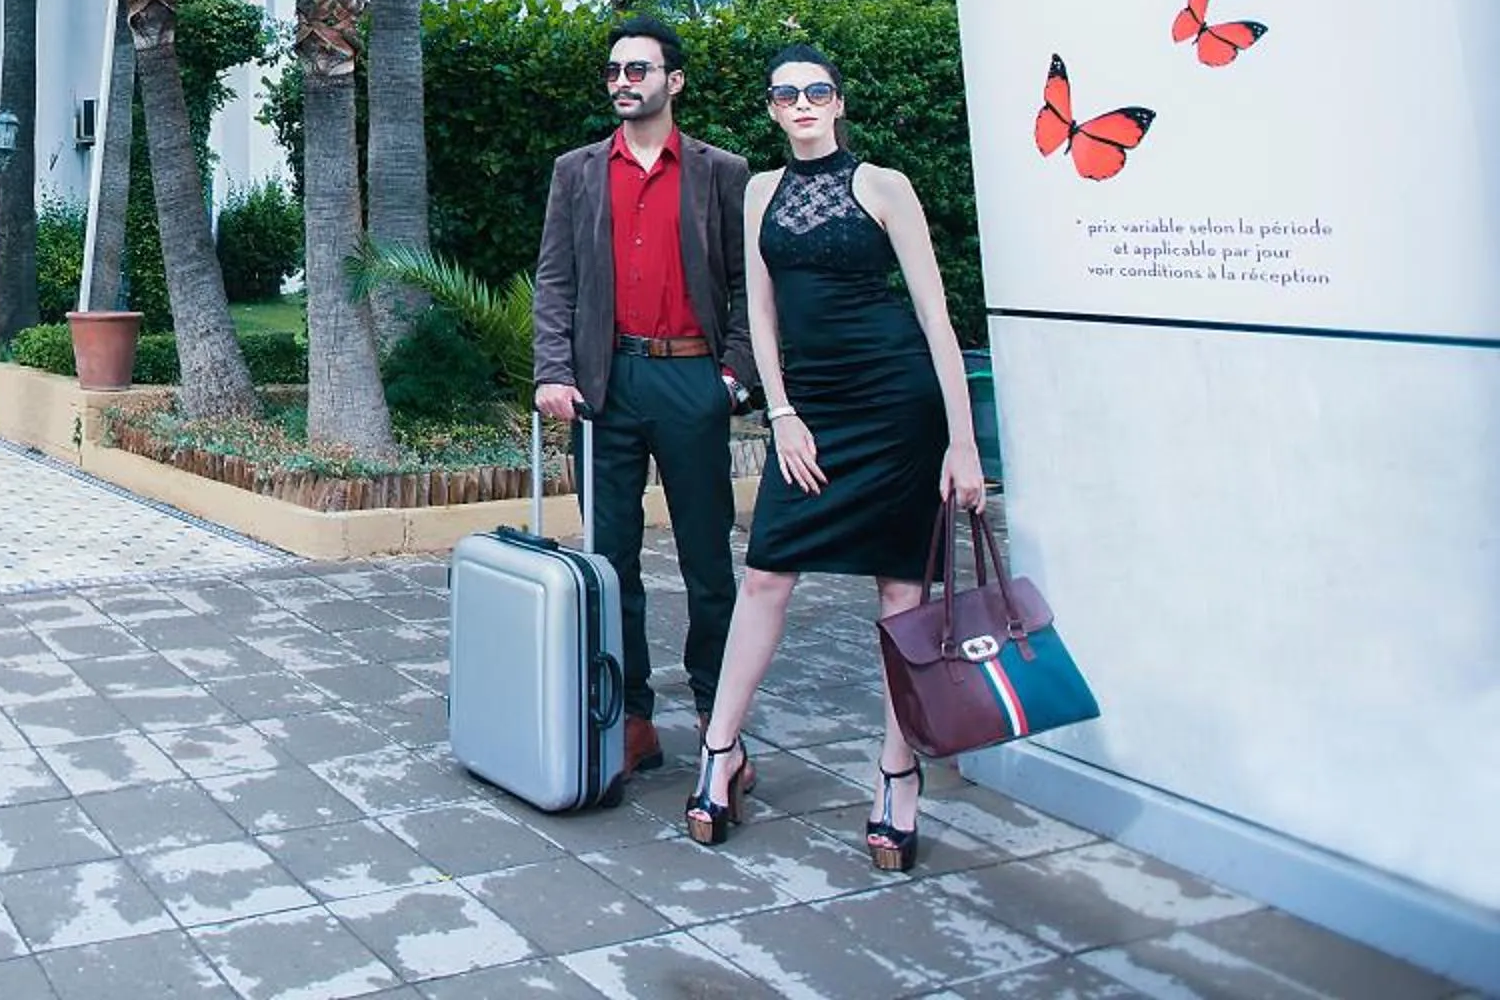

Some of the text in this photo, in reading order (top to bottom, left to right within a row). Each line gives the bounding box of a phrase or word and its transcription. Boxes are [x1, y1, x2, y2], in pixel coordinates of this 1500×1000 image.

[1087, 219, 1117, 237] prix
[1121, 218, 1184, 235] variable
[1189, 217, 1235, 235] selon
[1239, 218, 1254, 236] la
[1260, 218, 1332, 239] période
[1113, 240, 1292, 263] et applicable par jour
[1087, 262, 1331, 287] voir conditions à la réception
